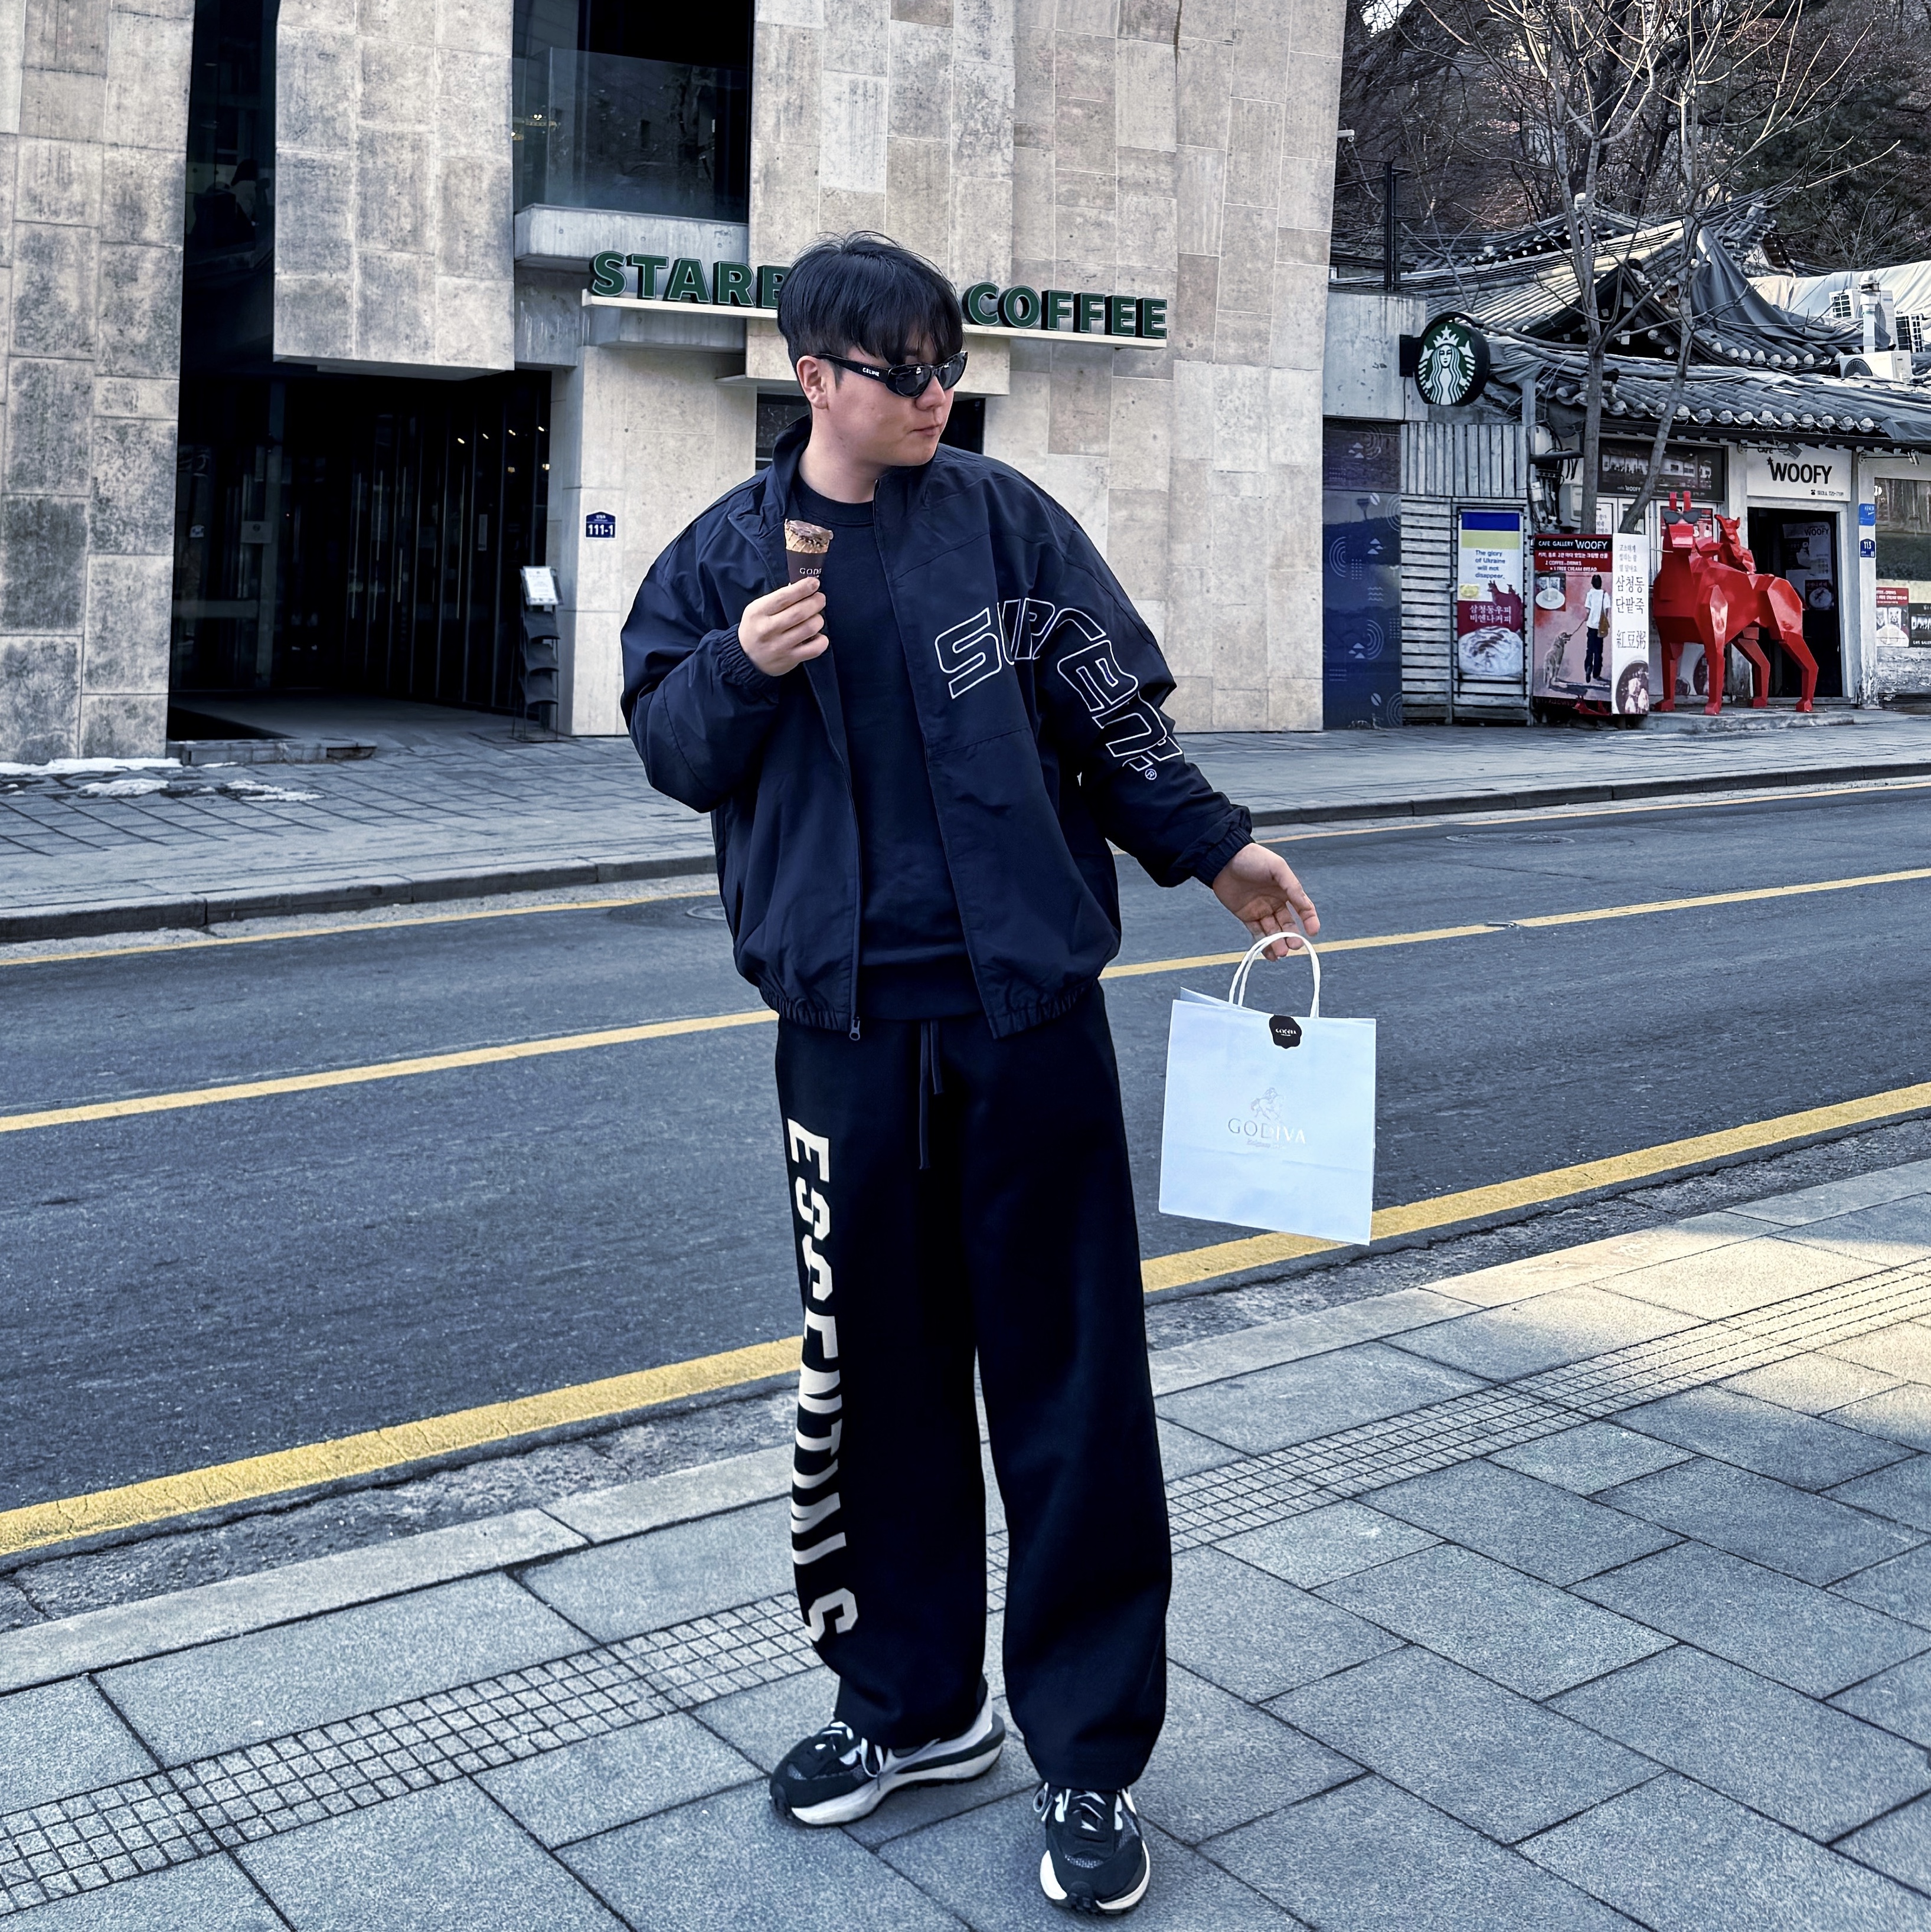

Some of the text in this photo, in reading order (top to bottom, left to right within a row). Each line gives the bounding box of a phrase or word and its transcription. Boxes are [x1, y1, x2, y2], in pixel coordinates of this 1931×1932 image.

[590, 251, 1167, 339] STARB COFFEE
[862, 367, 880, 377] CELINE
[1769, 461, 1832, 484] WOOFY
[589, 524, 613, 535] 111-1
[1574, 540, 1608, 550] WOOFY
[1616, 575, 1645, 593] 삼청동
[1469, 604, 1511, 614] 삼청동우피
[1616, 596, 1645, 614] 단팥죽
[1469, 614, 1511, 624] 비엔나커피
[1616, 630, 1646, 649] 紅豆粥
[1228, 1117, 1306, 1145] GODIVA
